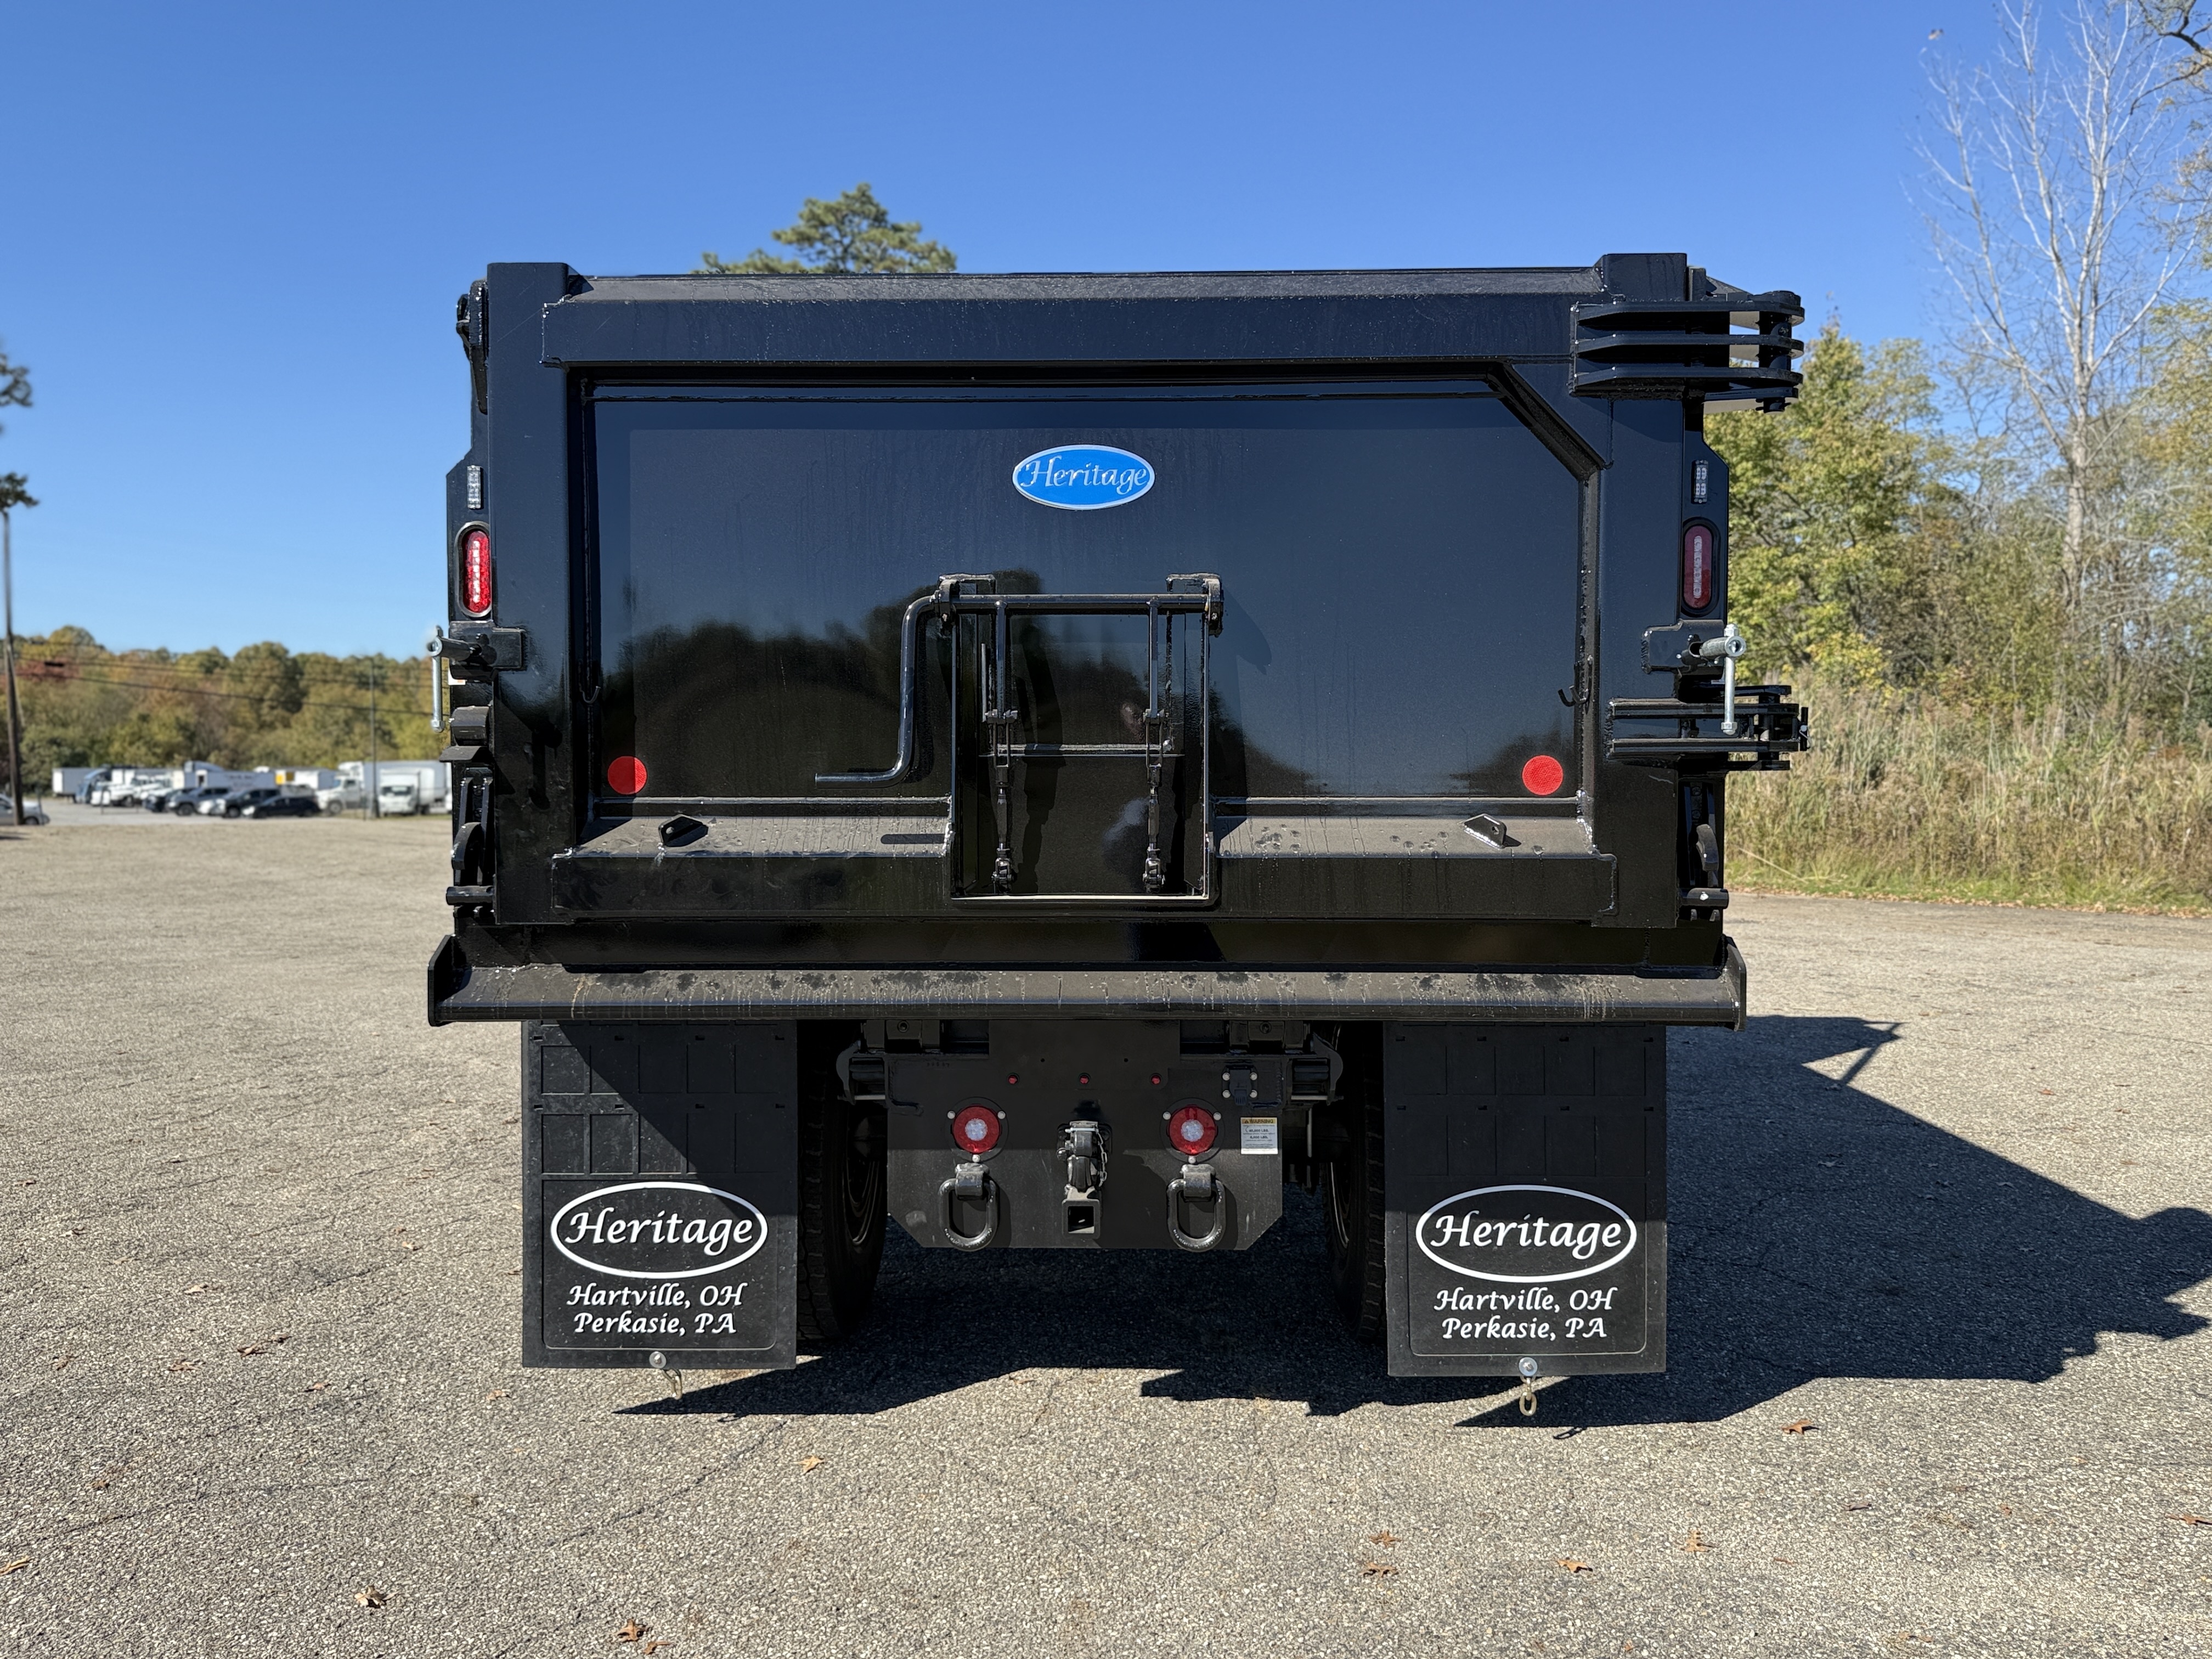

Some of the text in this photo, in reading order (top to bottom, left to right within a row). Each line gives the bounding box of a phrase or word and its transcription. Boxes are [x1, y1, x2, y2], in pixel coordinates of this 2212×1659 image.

[1021, 455, 1147, 494] Heritage
[565, 1207, 752, 1256] Heritage
[1430, 1210, 1621, 1260] Heritage
[567, 1283, 748, 1309] Hartville, OH
[1434, 1287, 1618, 1313] Hartville, OH
[574, 1311, 736, 1336] Perkasie, PA
[1442, 1315, 1607, 1341] Perkasie, PA
